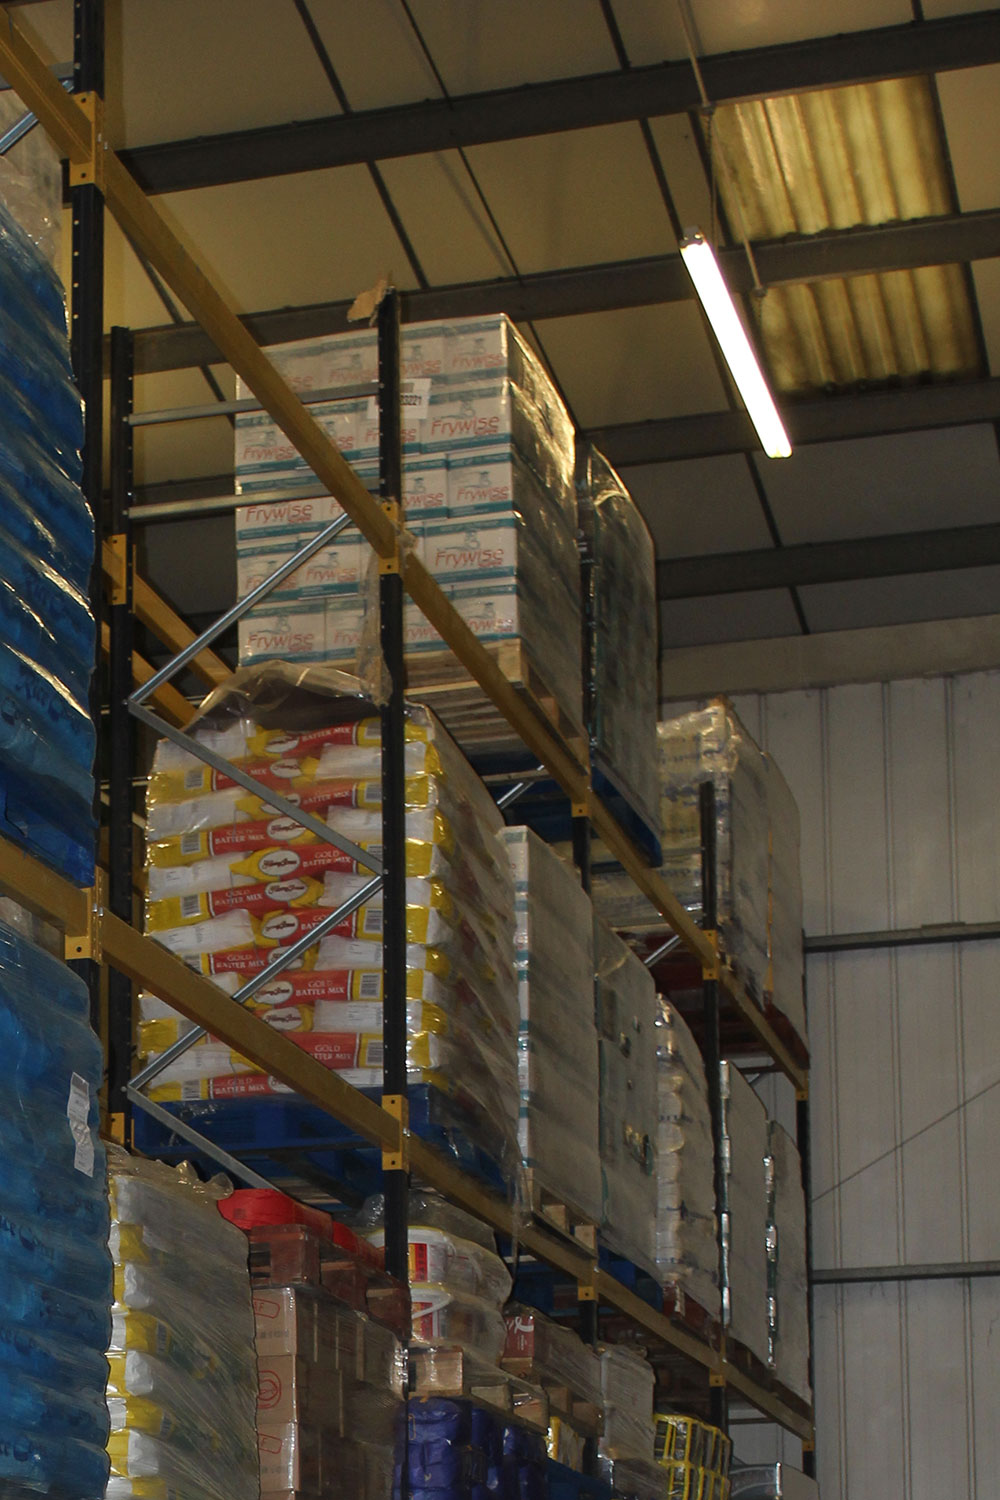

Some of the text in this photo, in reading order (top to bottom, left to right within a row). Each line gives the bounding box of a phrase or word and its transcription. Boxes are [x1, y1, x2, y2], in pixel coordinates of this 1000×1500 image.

[431, 416, 501, 436] Frywise
[245, 503, 314, 524] Frywise
[436, 549, 505, 569] Frywise
[248, 633, 315, 651] Frywise
[333, 726, 351, 735] MIX
[327, 986, 345, 995] MIX
